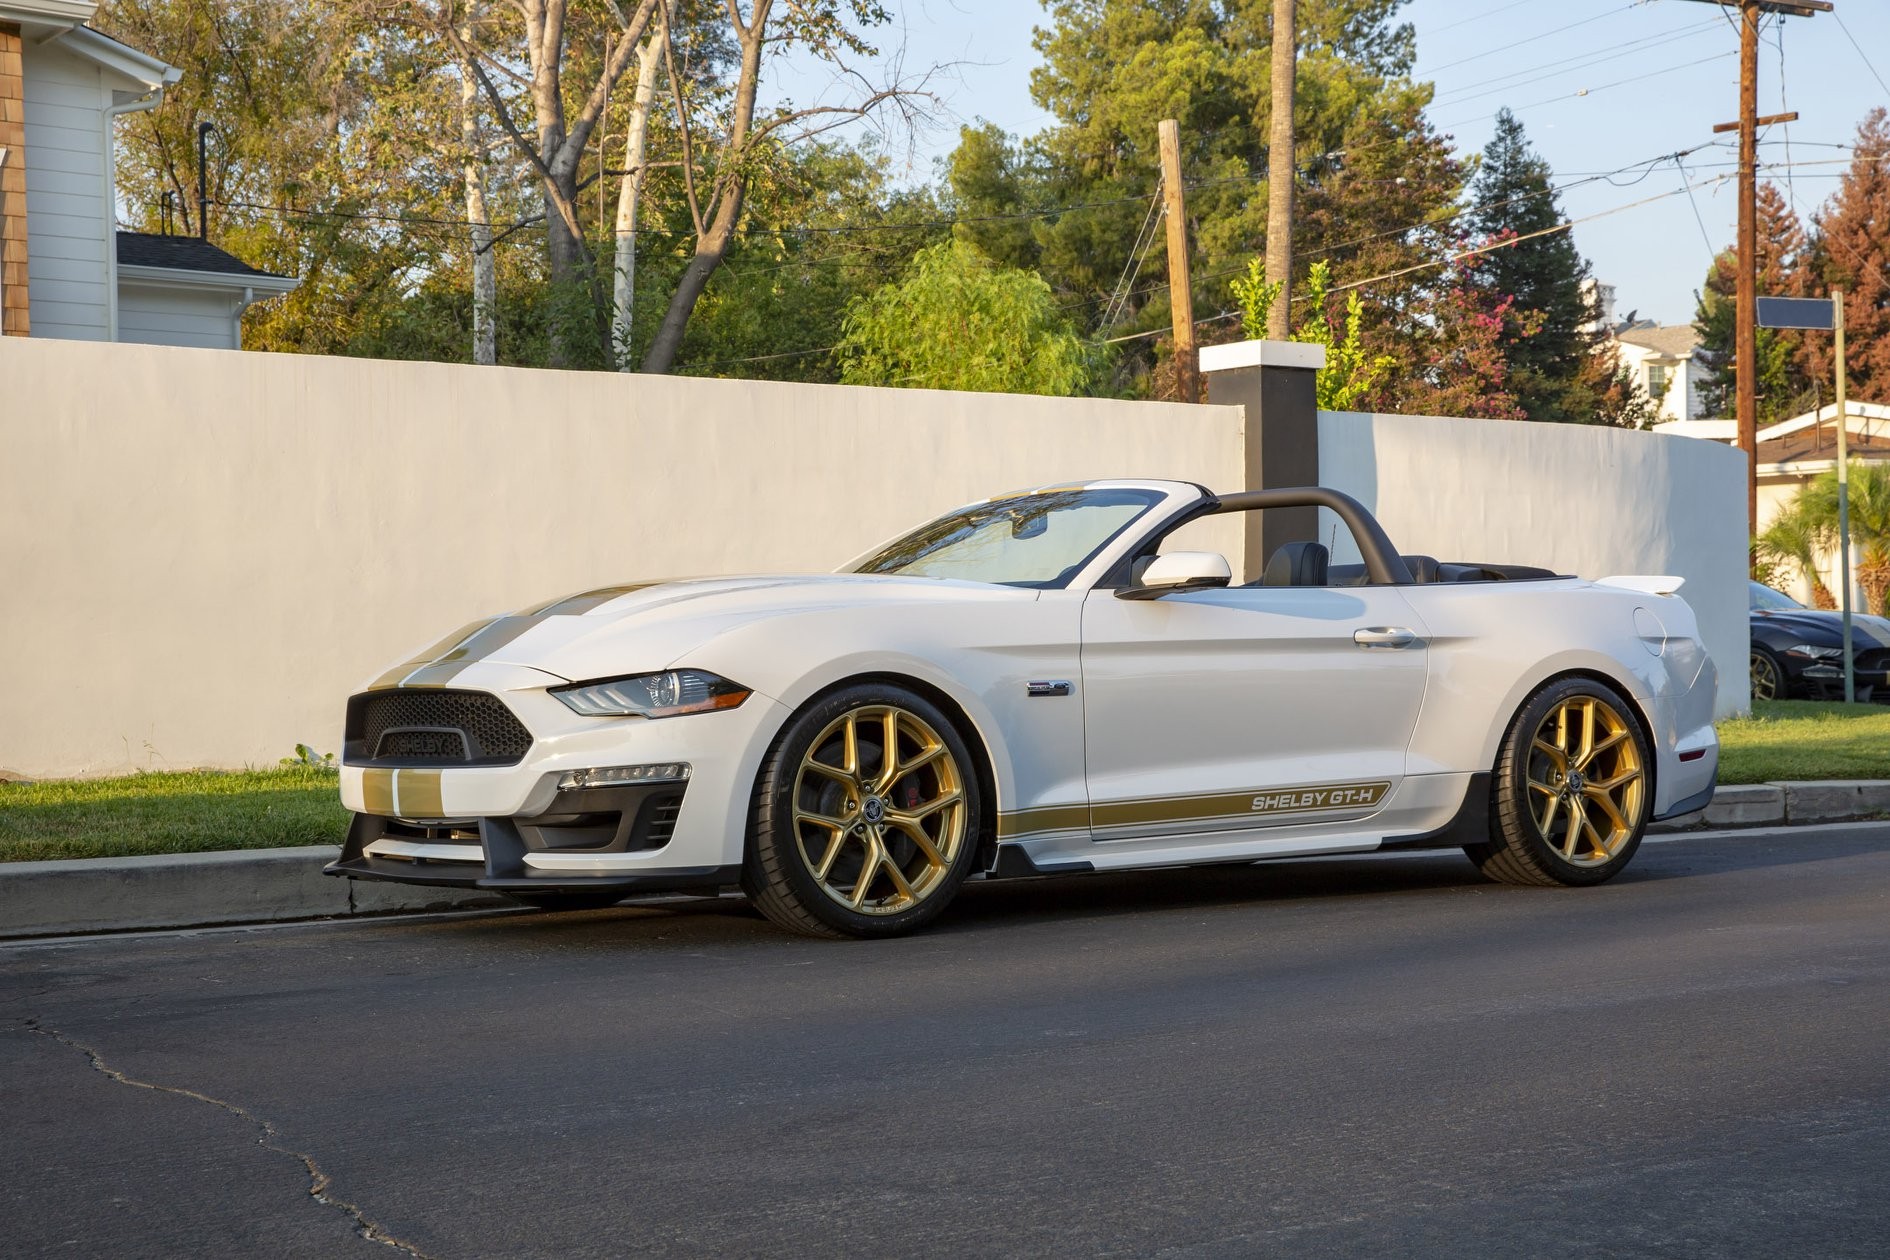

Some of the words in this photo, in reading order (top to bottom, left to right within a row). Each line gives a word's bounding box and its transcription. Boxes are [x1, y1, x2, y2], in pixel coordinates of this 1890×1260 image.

[399, 738, 445, 753] SHELBY
[1252, 792, 1327, 810] SHELBY
[1330, 789, 1374, 804] GT-H
